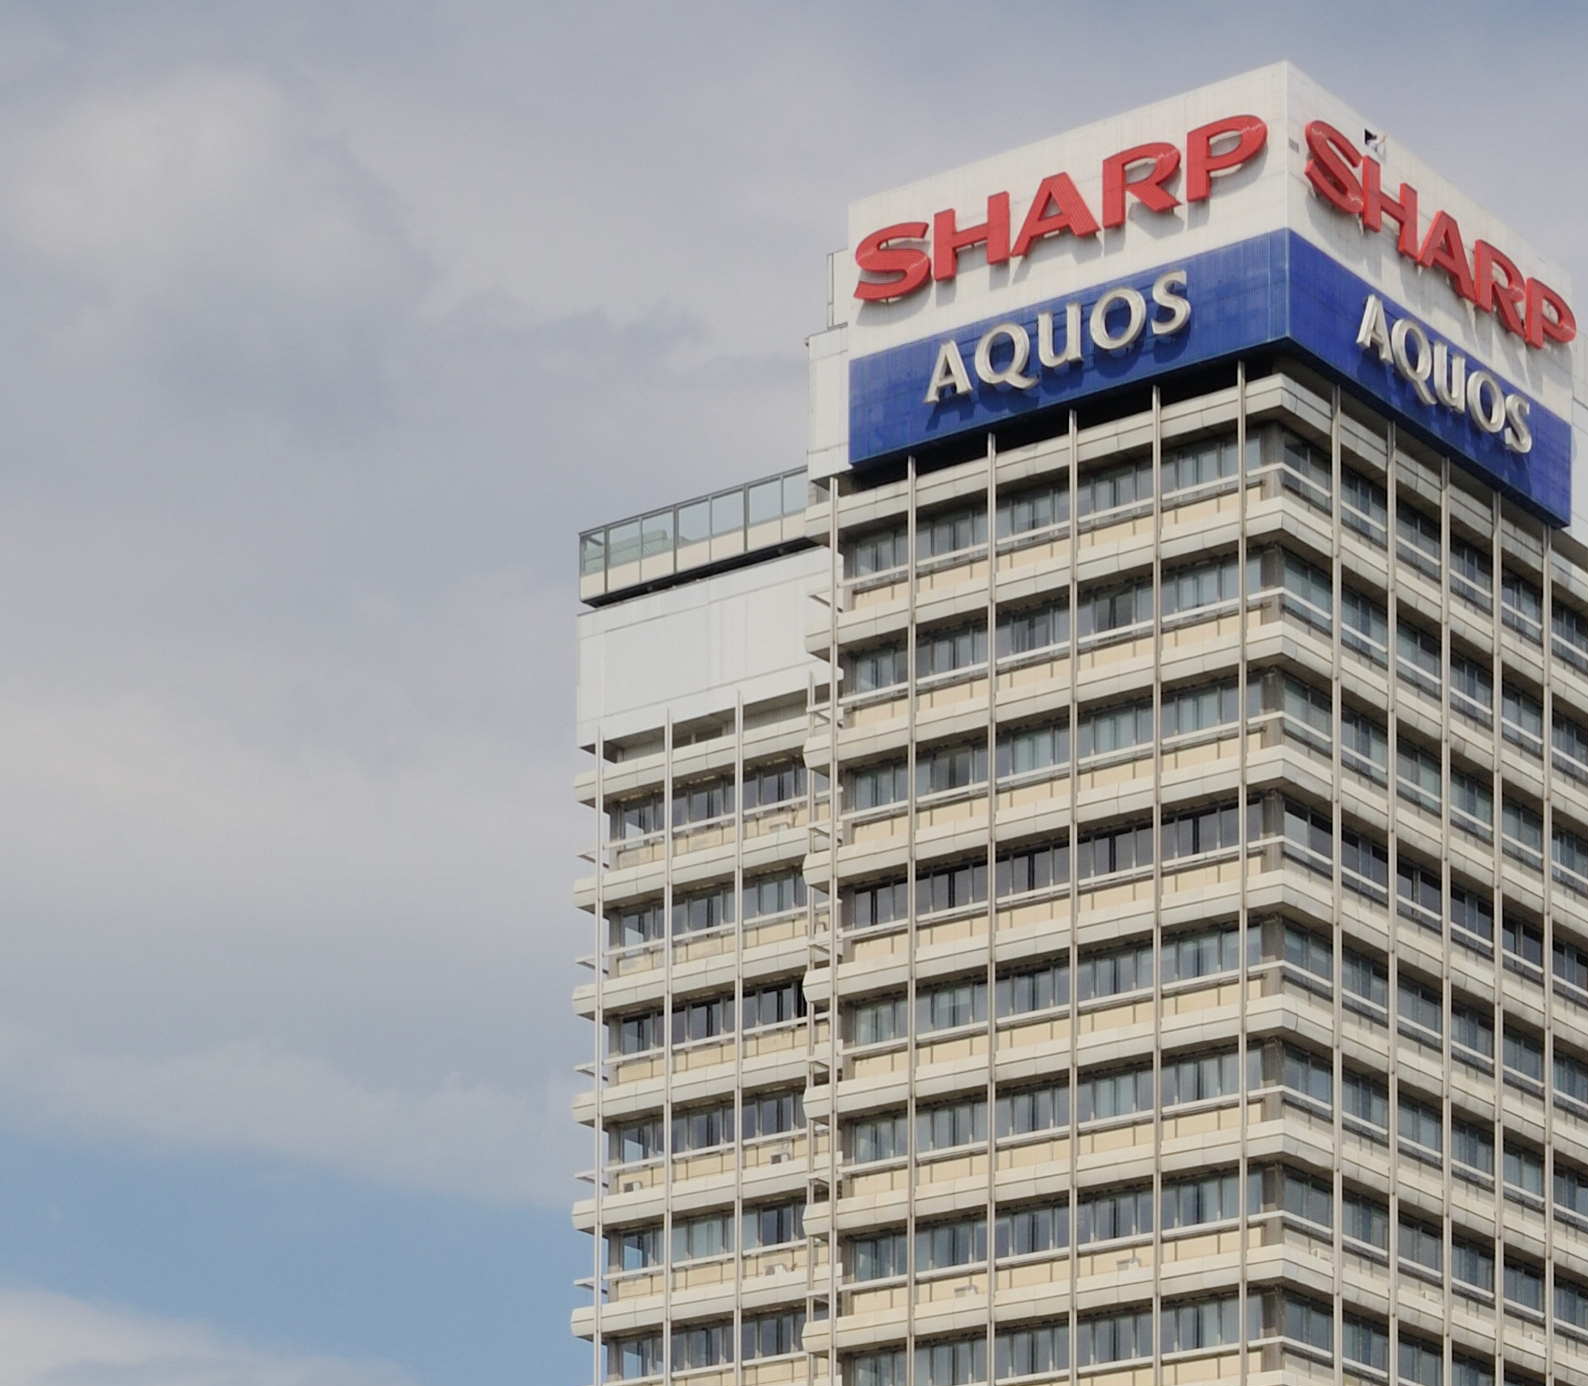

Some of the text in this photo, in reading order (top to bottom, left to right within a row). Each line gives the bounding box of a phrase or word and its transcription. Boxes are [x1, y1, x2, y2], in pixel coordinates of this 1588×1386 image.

[853, 114, 1268, 302] SHARP
[1304, 119, 1577, 349] SHARP
[925, 269, 1192, 404] AQUOS
[1355, 292, 1532, 454] AQUOS
